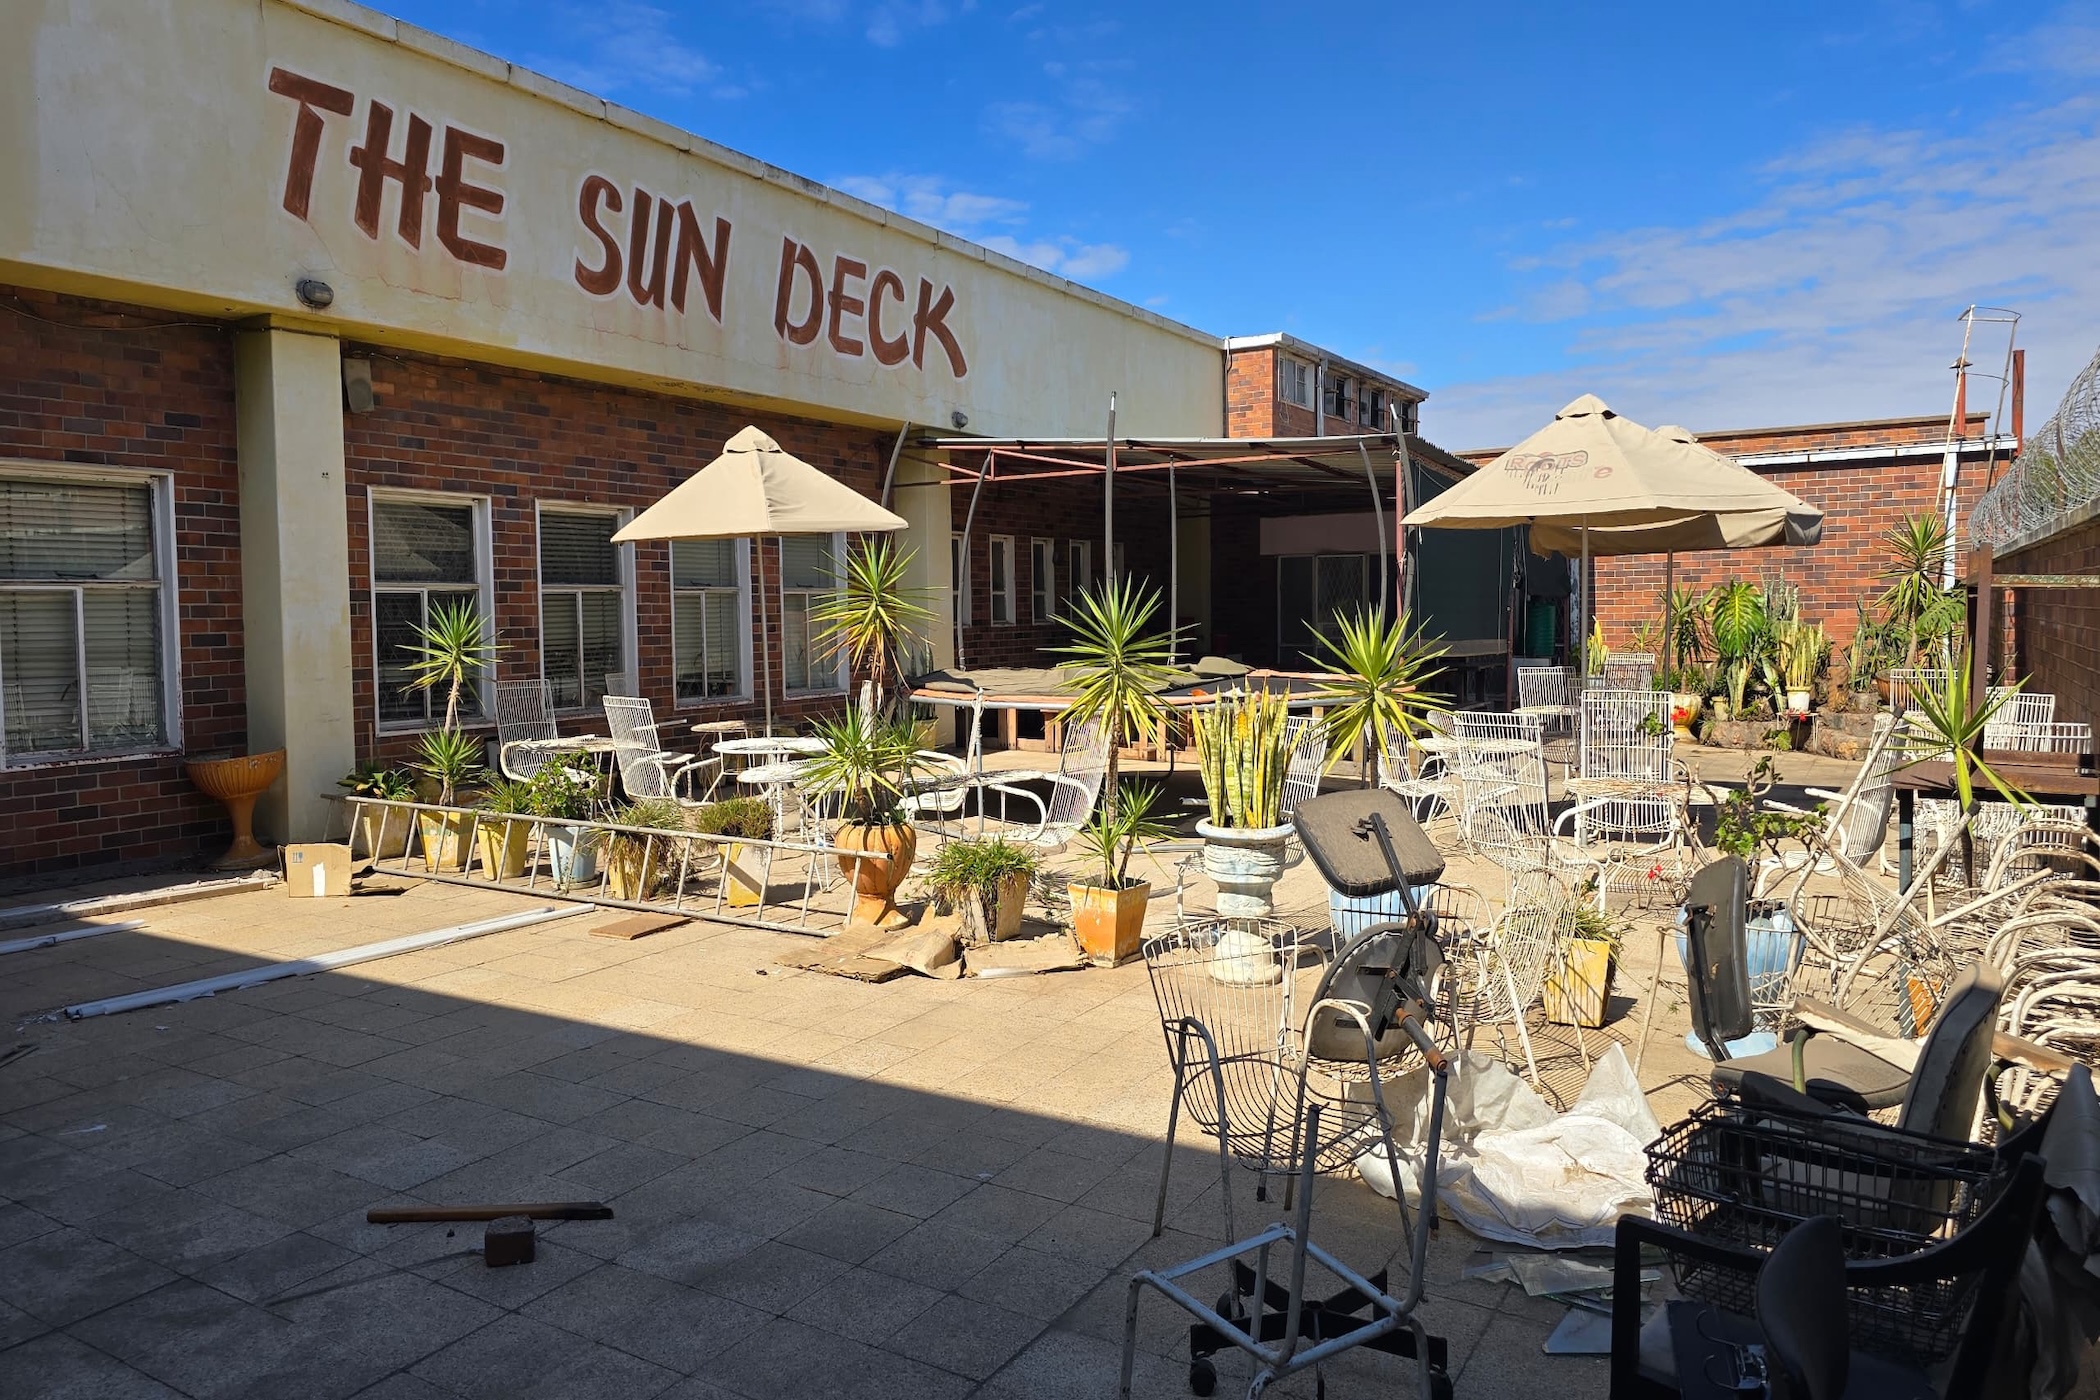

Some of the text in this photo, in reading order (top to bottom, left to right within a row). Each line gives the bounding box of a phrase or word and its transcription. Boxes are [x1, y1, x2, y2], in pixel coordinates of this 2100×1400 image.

[268, 67, 967, 378] THE SUN DECK
